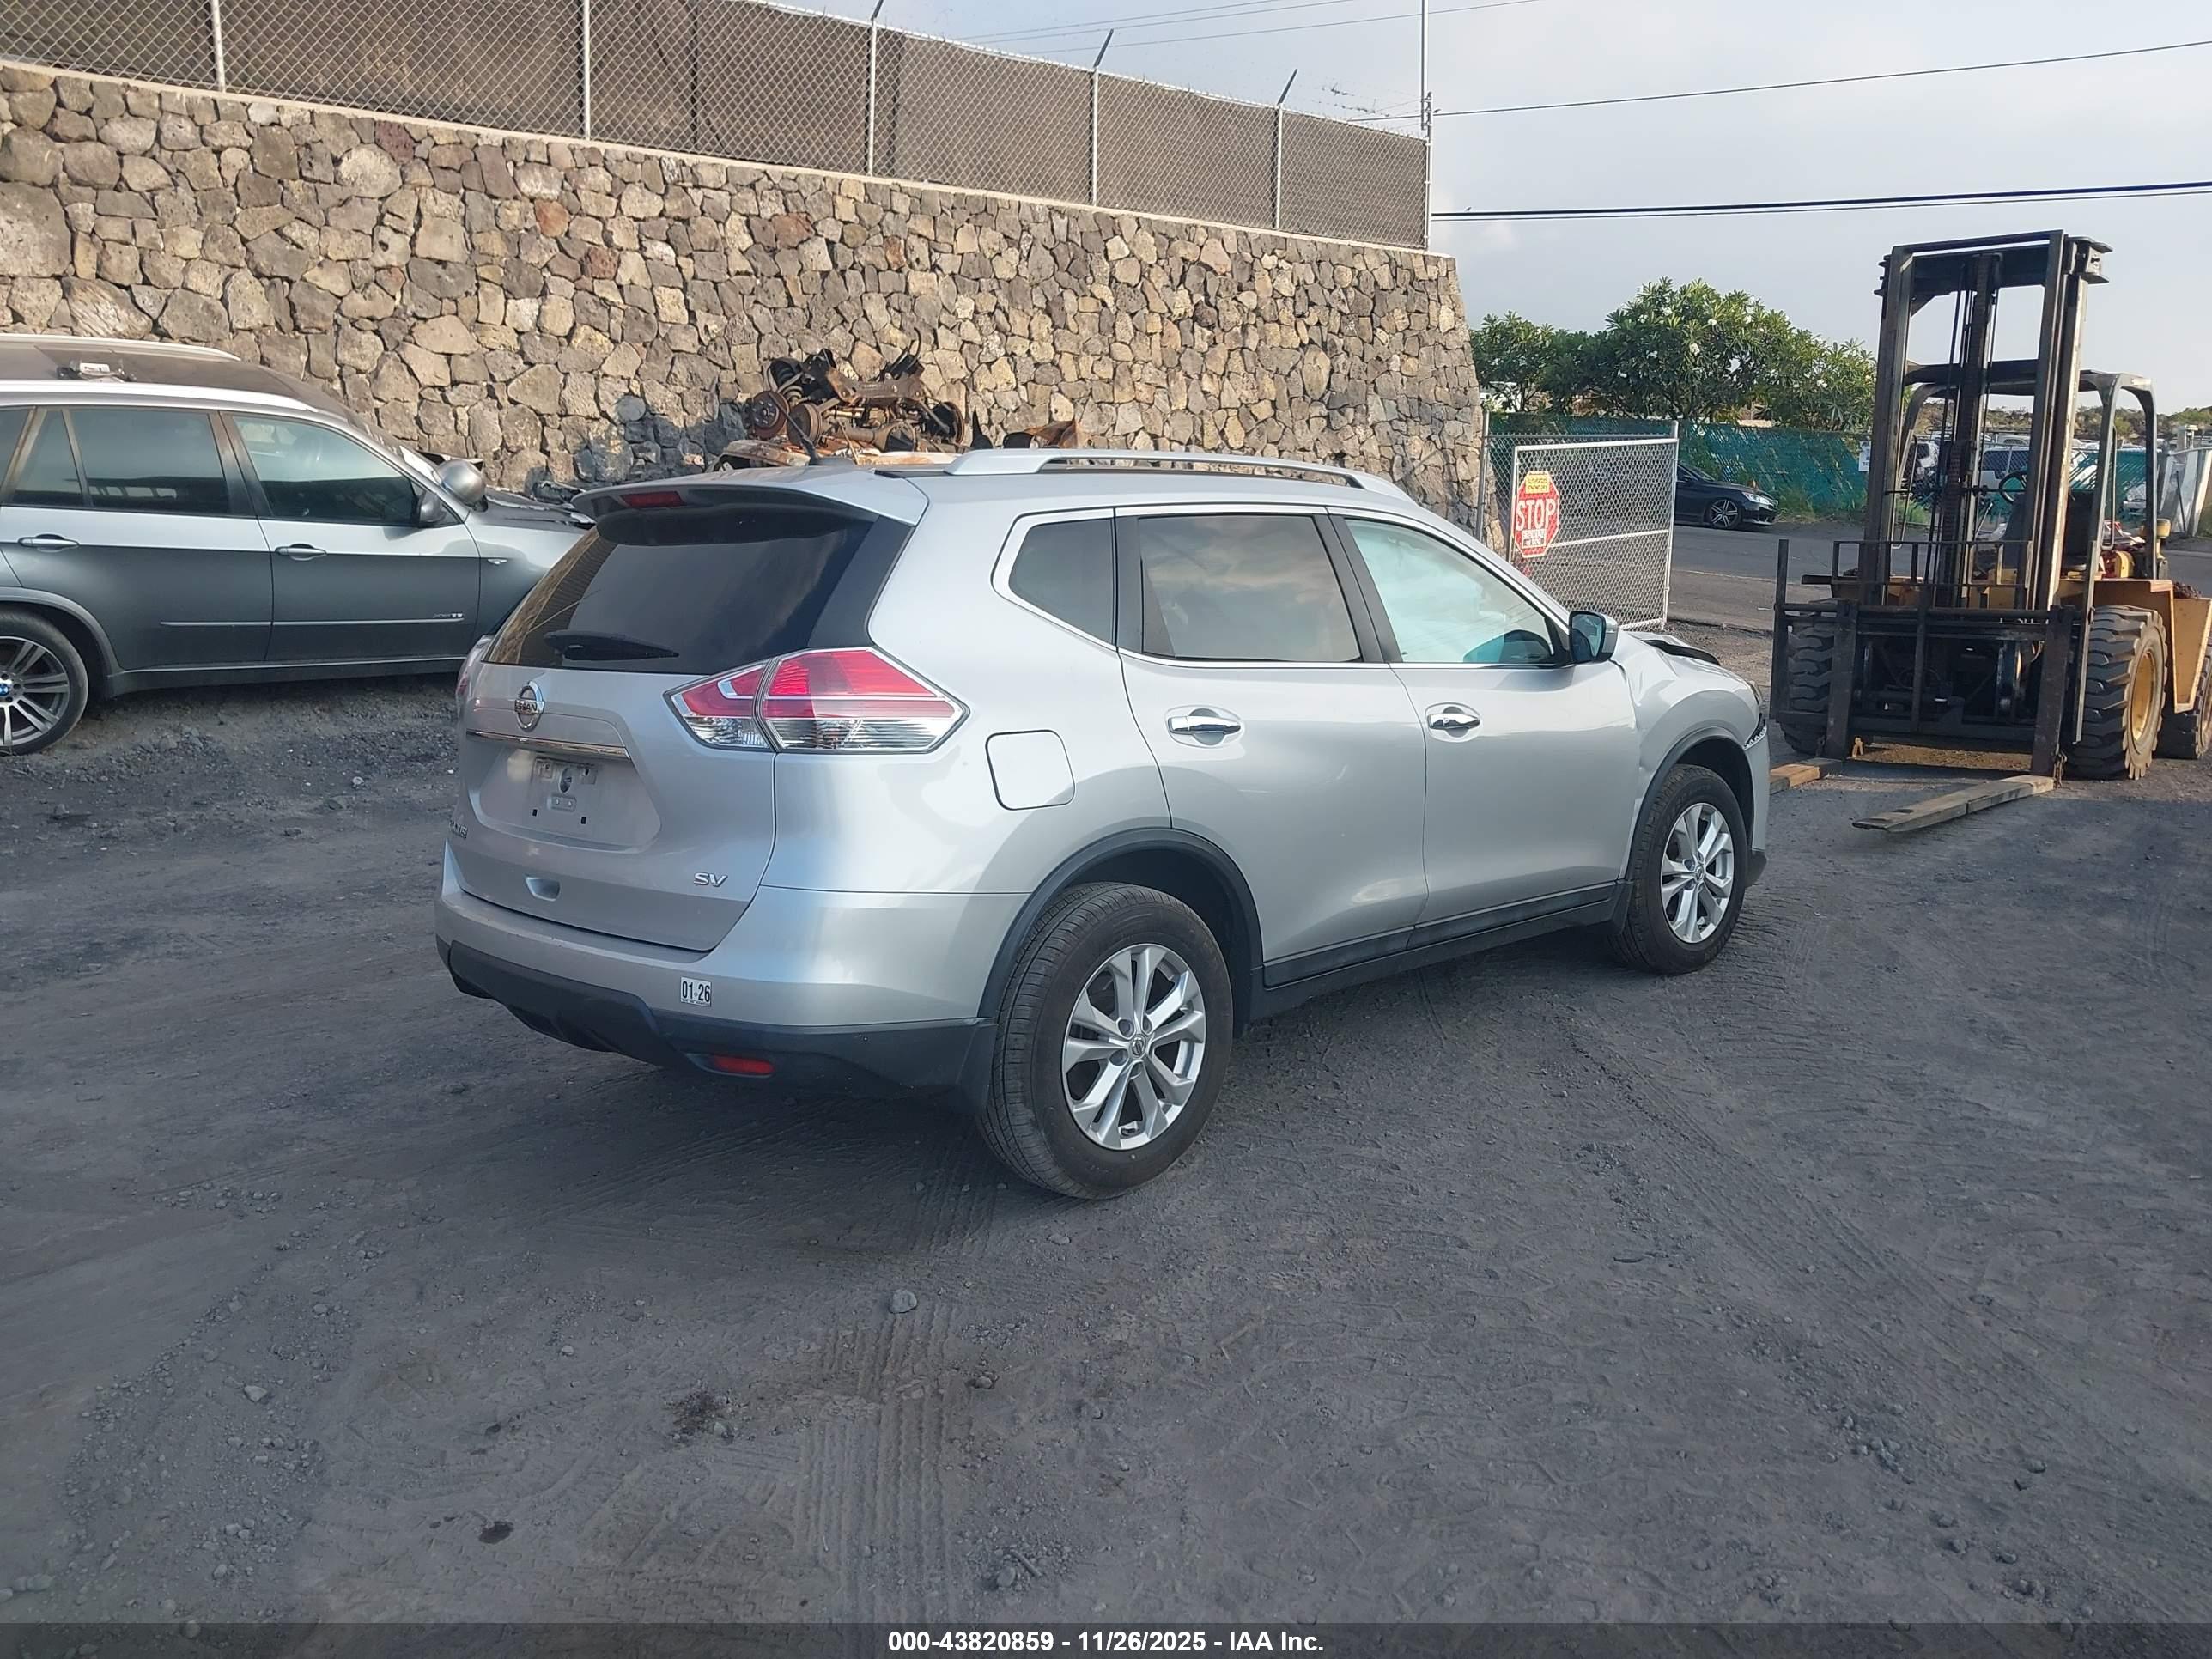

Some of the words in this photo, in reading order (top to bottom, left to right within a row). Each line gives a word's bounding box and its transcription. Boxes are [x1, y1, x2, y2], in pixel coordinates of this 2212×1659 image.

[1516, 498, 1556, 531] STOP
[515, 700, 538, 712] SSAN
[694, 872, 728, 888] SV
